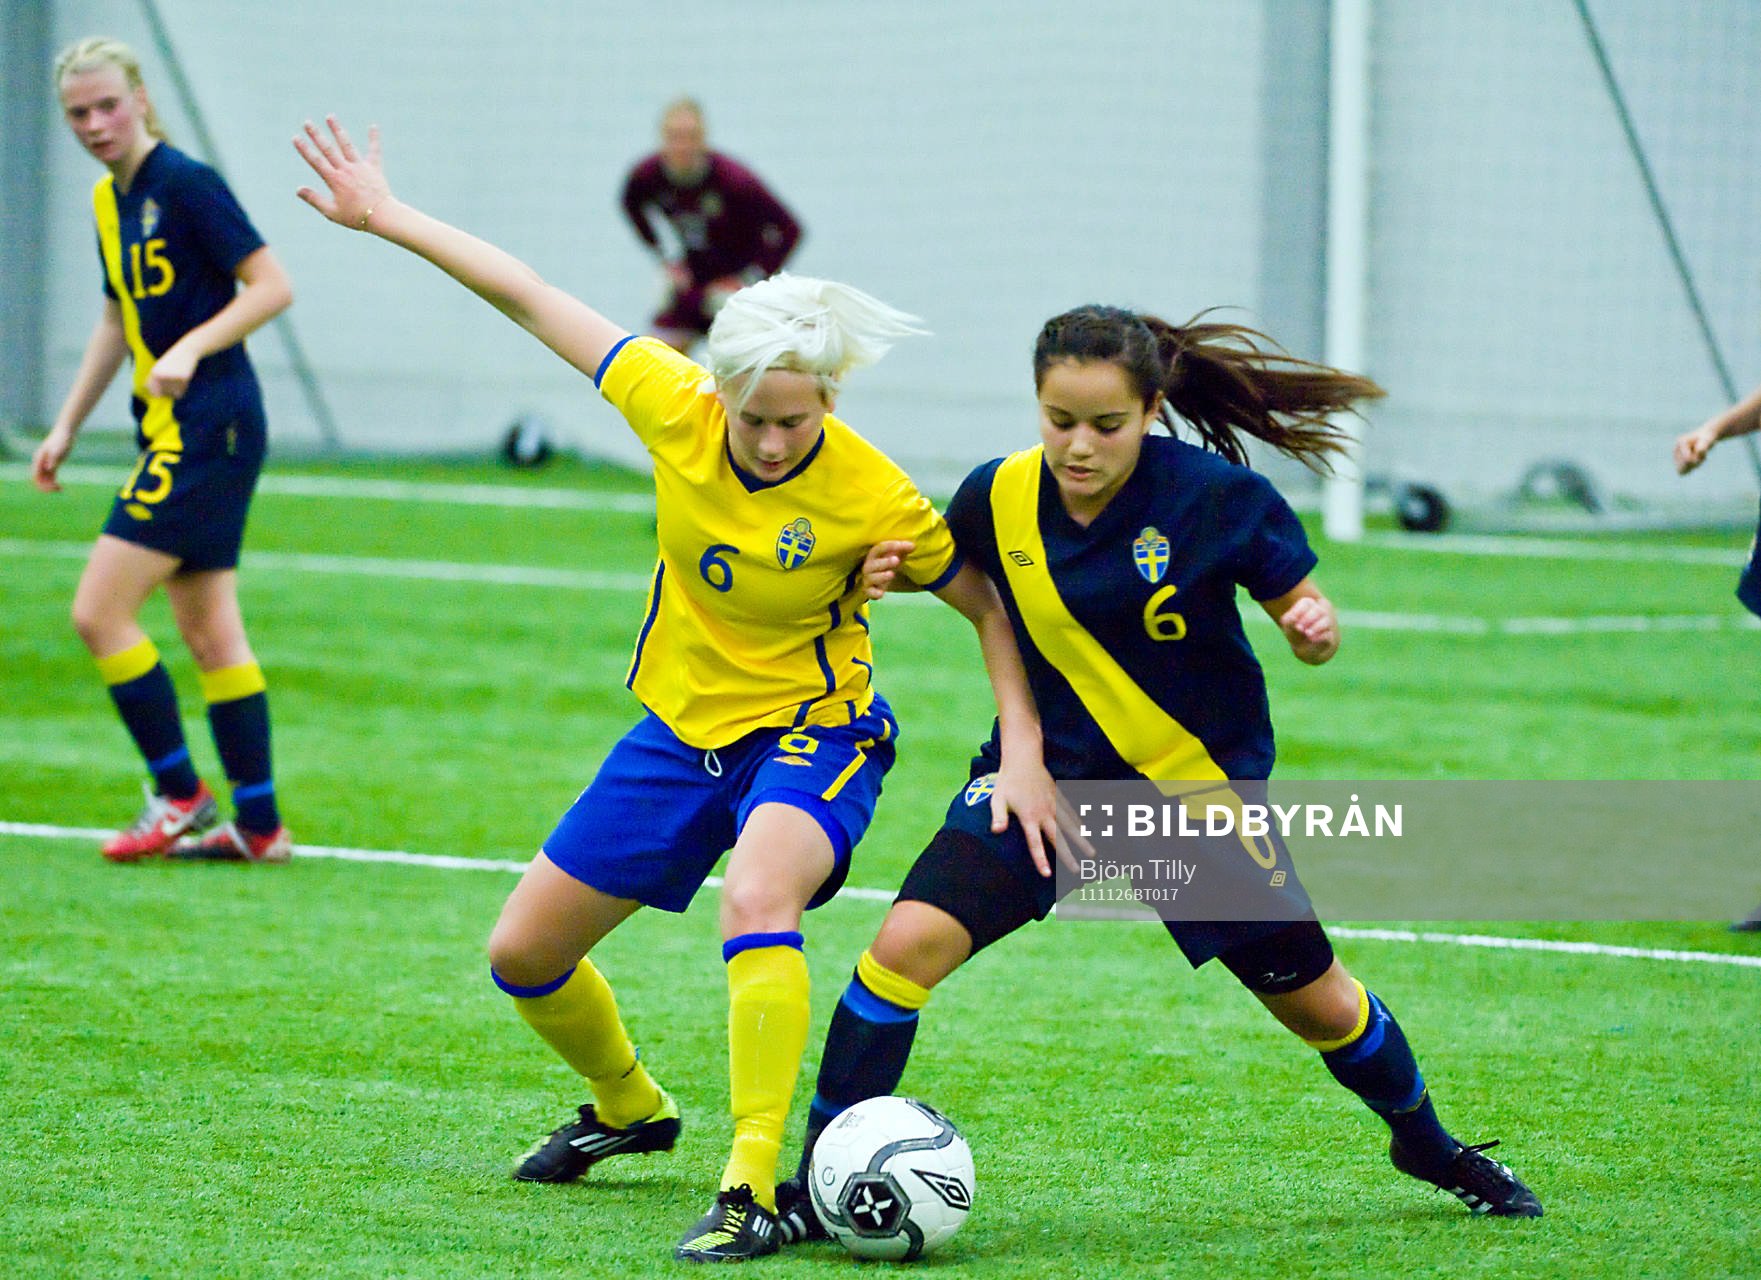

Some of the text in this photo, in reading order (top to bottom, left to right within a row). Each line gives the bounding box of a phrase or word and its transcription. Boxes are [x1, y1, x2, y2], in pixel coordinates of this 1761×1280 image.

[130, 238, 175, 299] 15
[119, 450, 182, 504] 15
[700, 543, 740, 593] 6
[1143, 584, 1187, 641] 6
